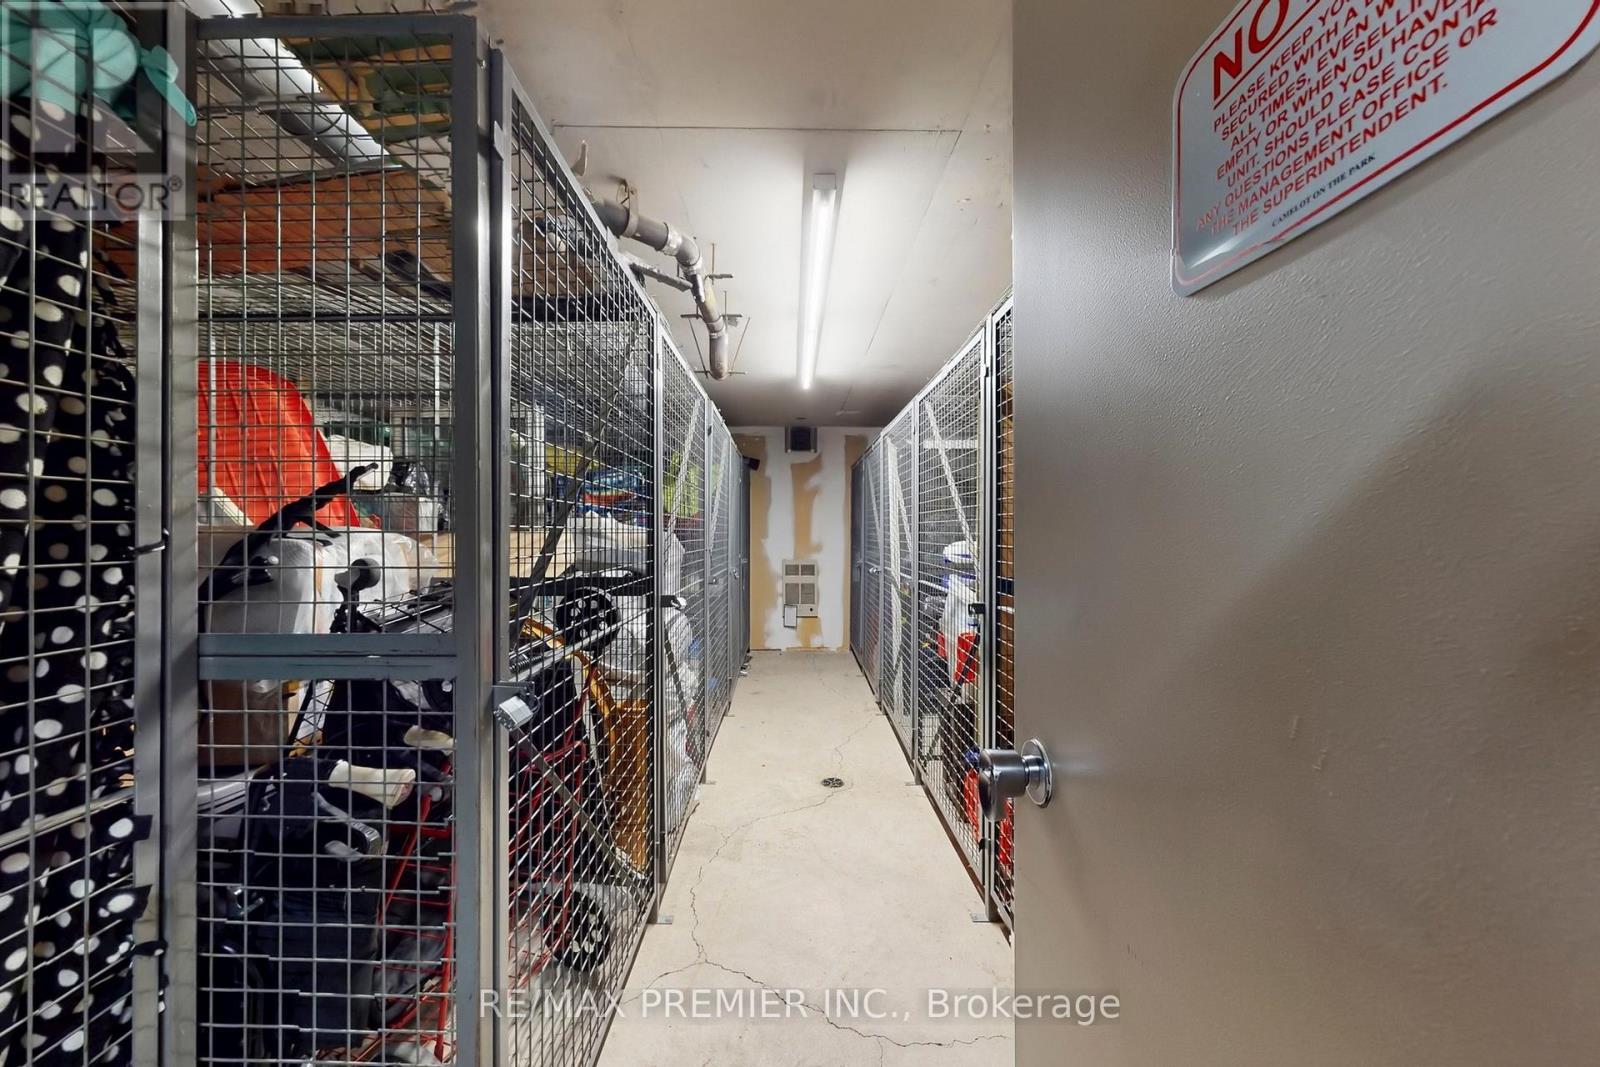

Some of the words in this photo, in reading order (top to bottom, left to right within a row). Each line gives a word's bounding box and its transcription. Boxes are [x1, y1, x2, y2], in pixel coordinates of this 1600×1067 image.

[1213, 0, 1309, 100] NO
[1214, 72, 1266, 133] PLEASE
[1270, 26, 1314, 77] KEEP
[1318, 0, 1350, 27] YO
[1222, 70, 1289, 141] SECURED
[1294, 21, 1338, 72] WITH
[1344, 7, 1358, 28] A
[1231, 122, 1256, 150] ALL
[1259, 73, 1311, 122] TIMES,
[1317, 15, 1368, 73] EVEN
[1196, 202, 1222, 232] ANY
[1224, 131, 1309, 207] QUESTIONS
[1315, 61, 1396, 136] PLEASE
[1211, 206, 1237, 235] THE
[1238, 115, 1356, 217] MANAGEMENT
[1362, 44, 1449, 120] OFFICE
[1459, 8, 1497, 48] OR
[1216, 133, 1261, 181] EMPTY
[1265, 110, 1288, 137] OR
[1292, 57, 1347, 113] WHEN
[1227, 156, 1260, 188] UNIT.
[1265, 92, 1333, 157] SHOULD
[1339, 49, 1383, 94] YOU
[1232, 213, 1259, 236] THE
[1263, 72, 1448, 215] SUPERINTENDENT.
[1271, 197, 1312, 227] CAMELOT
[1312, 187, 1326, 199] ON
[1328, 174, 1346, 190] THE
[1348, 153, 1376, 177] PARK
